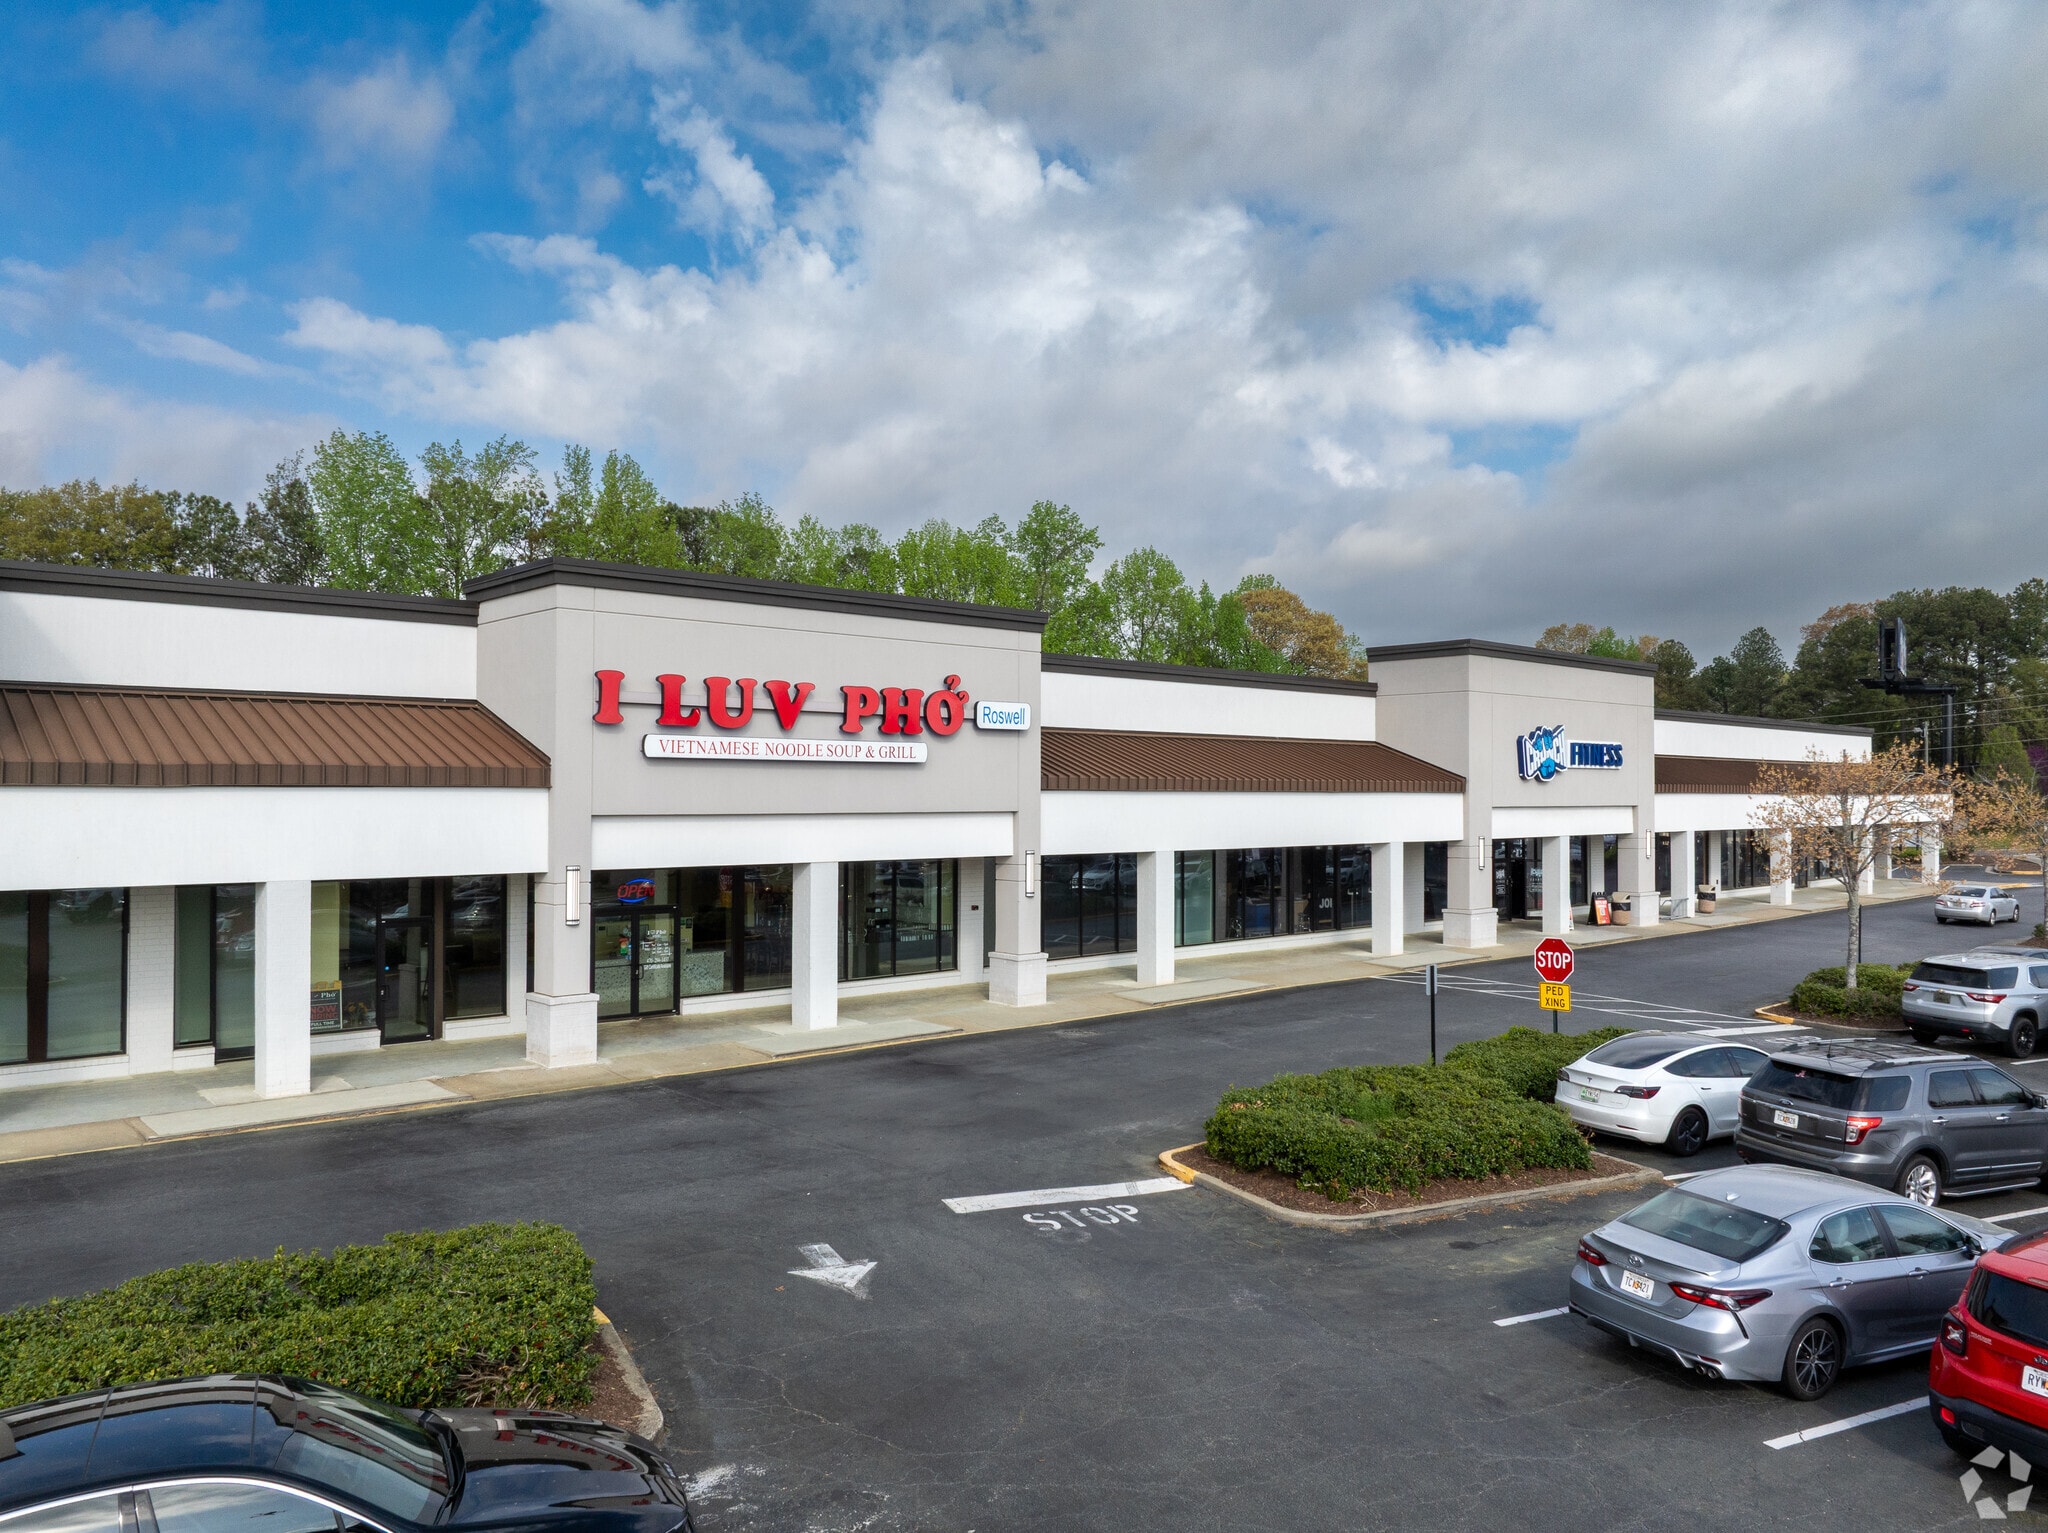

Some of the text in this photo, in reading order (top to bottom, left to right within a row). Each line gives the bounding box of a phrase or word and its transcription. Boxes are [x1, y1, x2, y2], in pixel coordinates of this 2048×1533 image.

[593, 670, 625, 725] I
[655, 674, 816, 731] LUV
[982, 706, 1026, 726] Roswell
[659, 739, 917, 760] VIETNAMESE NOODLE SOUP & GRILL
[1525, 730, 1623, 777] CRUNCH FITNESS
[617, 882, 656, 898] OPEN
[1537, 950, 1571, 969] STOP
[1546, 986, 1564, 996] PED
[1545, 998, 1566, 1008] XING
[1022, 1204, 1139, 1231] STOP
